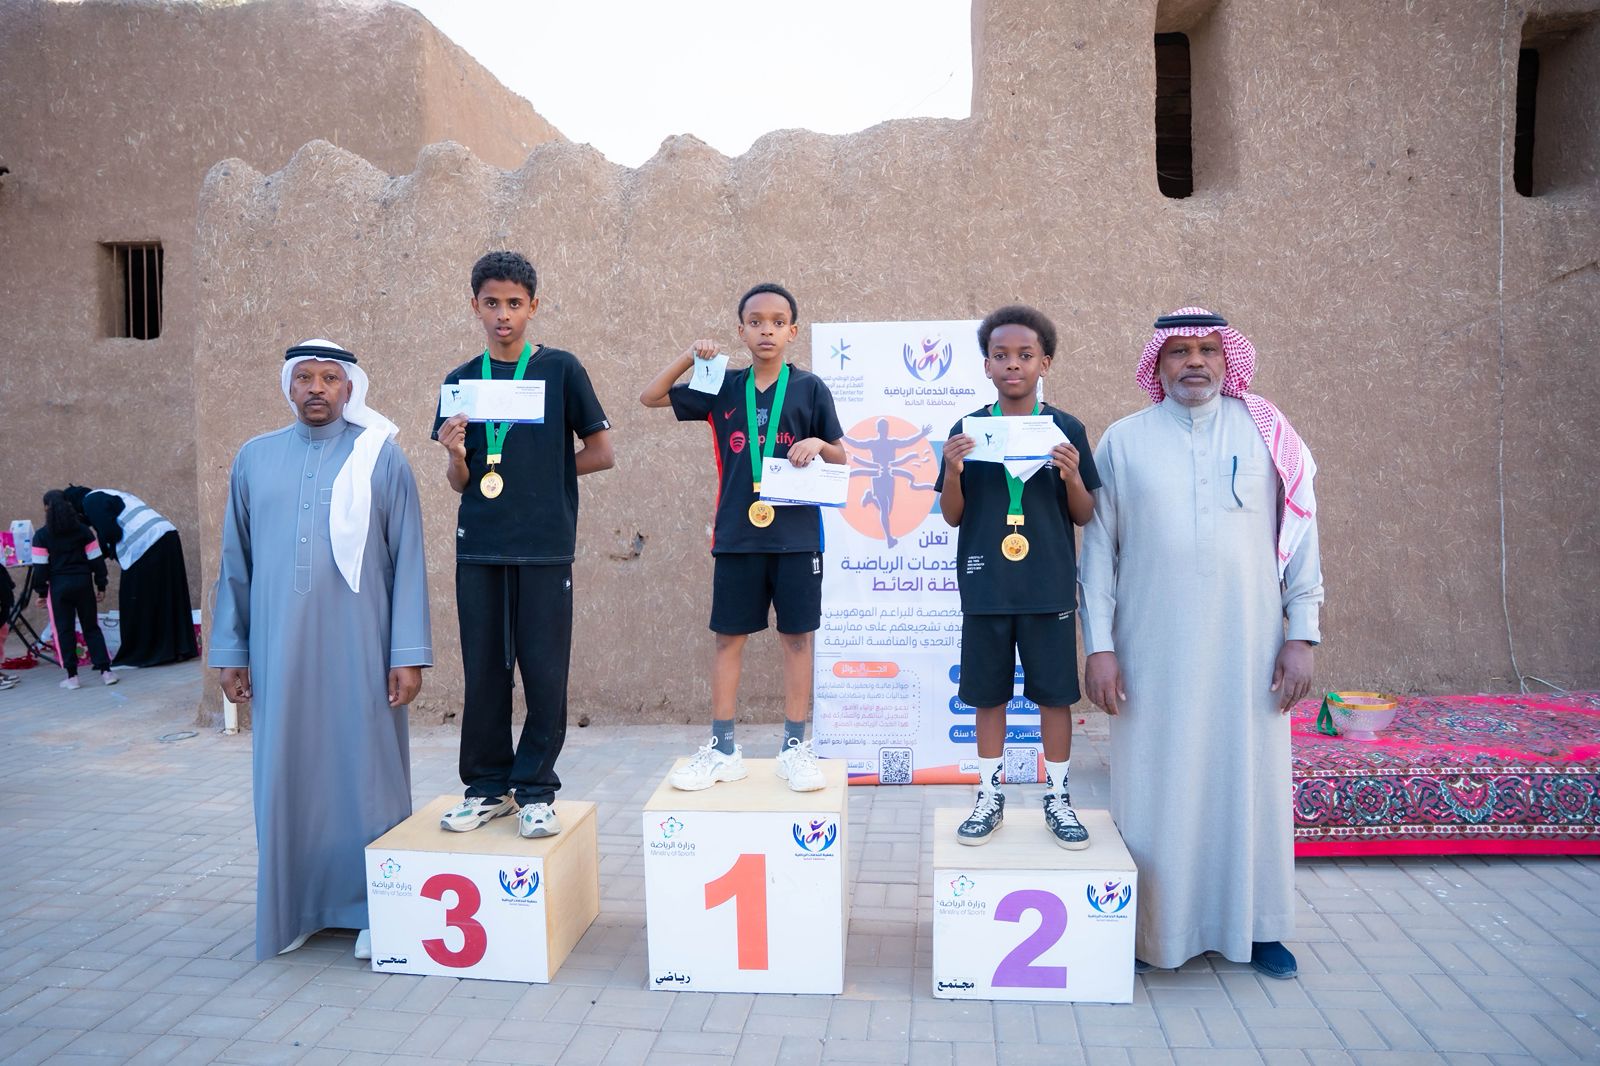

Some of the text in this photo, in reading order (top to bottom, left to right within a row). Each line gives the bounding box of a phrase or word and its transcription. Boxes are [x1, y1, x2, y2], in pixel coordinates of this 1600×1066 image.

[884, 386, 976, 398] جمعية الخدمات الرياضية
[748, 432, 795, 447] ptify
[919, 531, 948, 548] تعلن
[841, 556, 903, 574] الرياضية
[907, 556, 958, 570] خدمات
[872, 577, 923, 591] الحائط
[824, 607, 878, 619] الموهوبين
[880, 607, 914, 619] للبراعم
[824, 622, 863, 633] ممارسة
[864, 622, 887, 632] على
[890, 622, 941, 634] تشجيعهم
[824, 636, 864, 648] الشريفة
[866, 636, 918, 648] والمنافسة
[920, 636, 955, 648] التحدي
[953, 730, 970, 738] سنة
[1016, 730, 1042, 740] جنسين
[650, 840, 696, 850] وزارة الرياضة
[372, 880, 412, 892] وزارة الرياضة
[940, 900, 986, 908] وزارة الرياضة
[704, 854, 768, 970] 1
[420, 874, 488, 968] 3
[991, 890, 1068, 988] 2
[376, 956, 408, 968] صحي
[655, 972, 690, 984] رياضي
[938, 978, 975, 992] مجتمع
